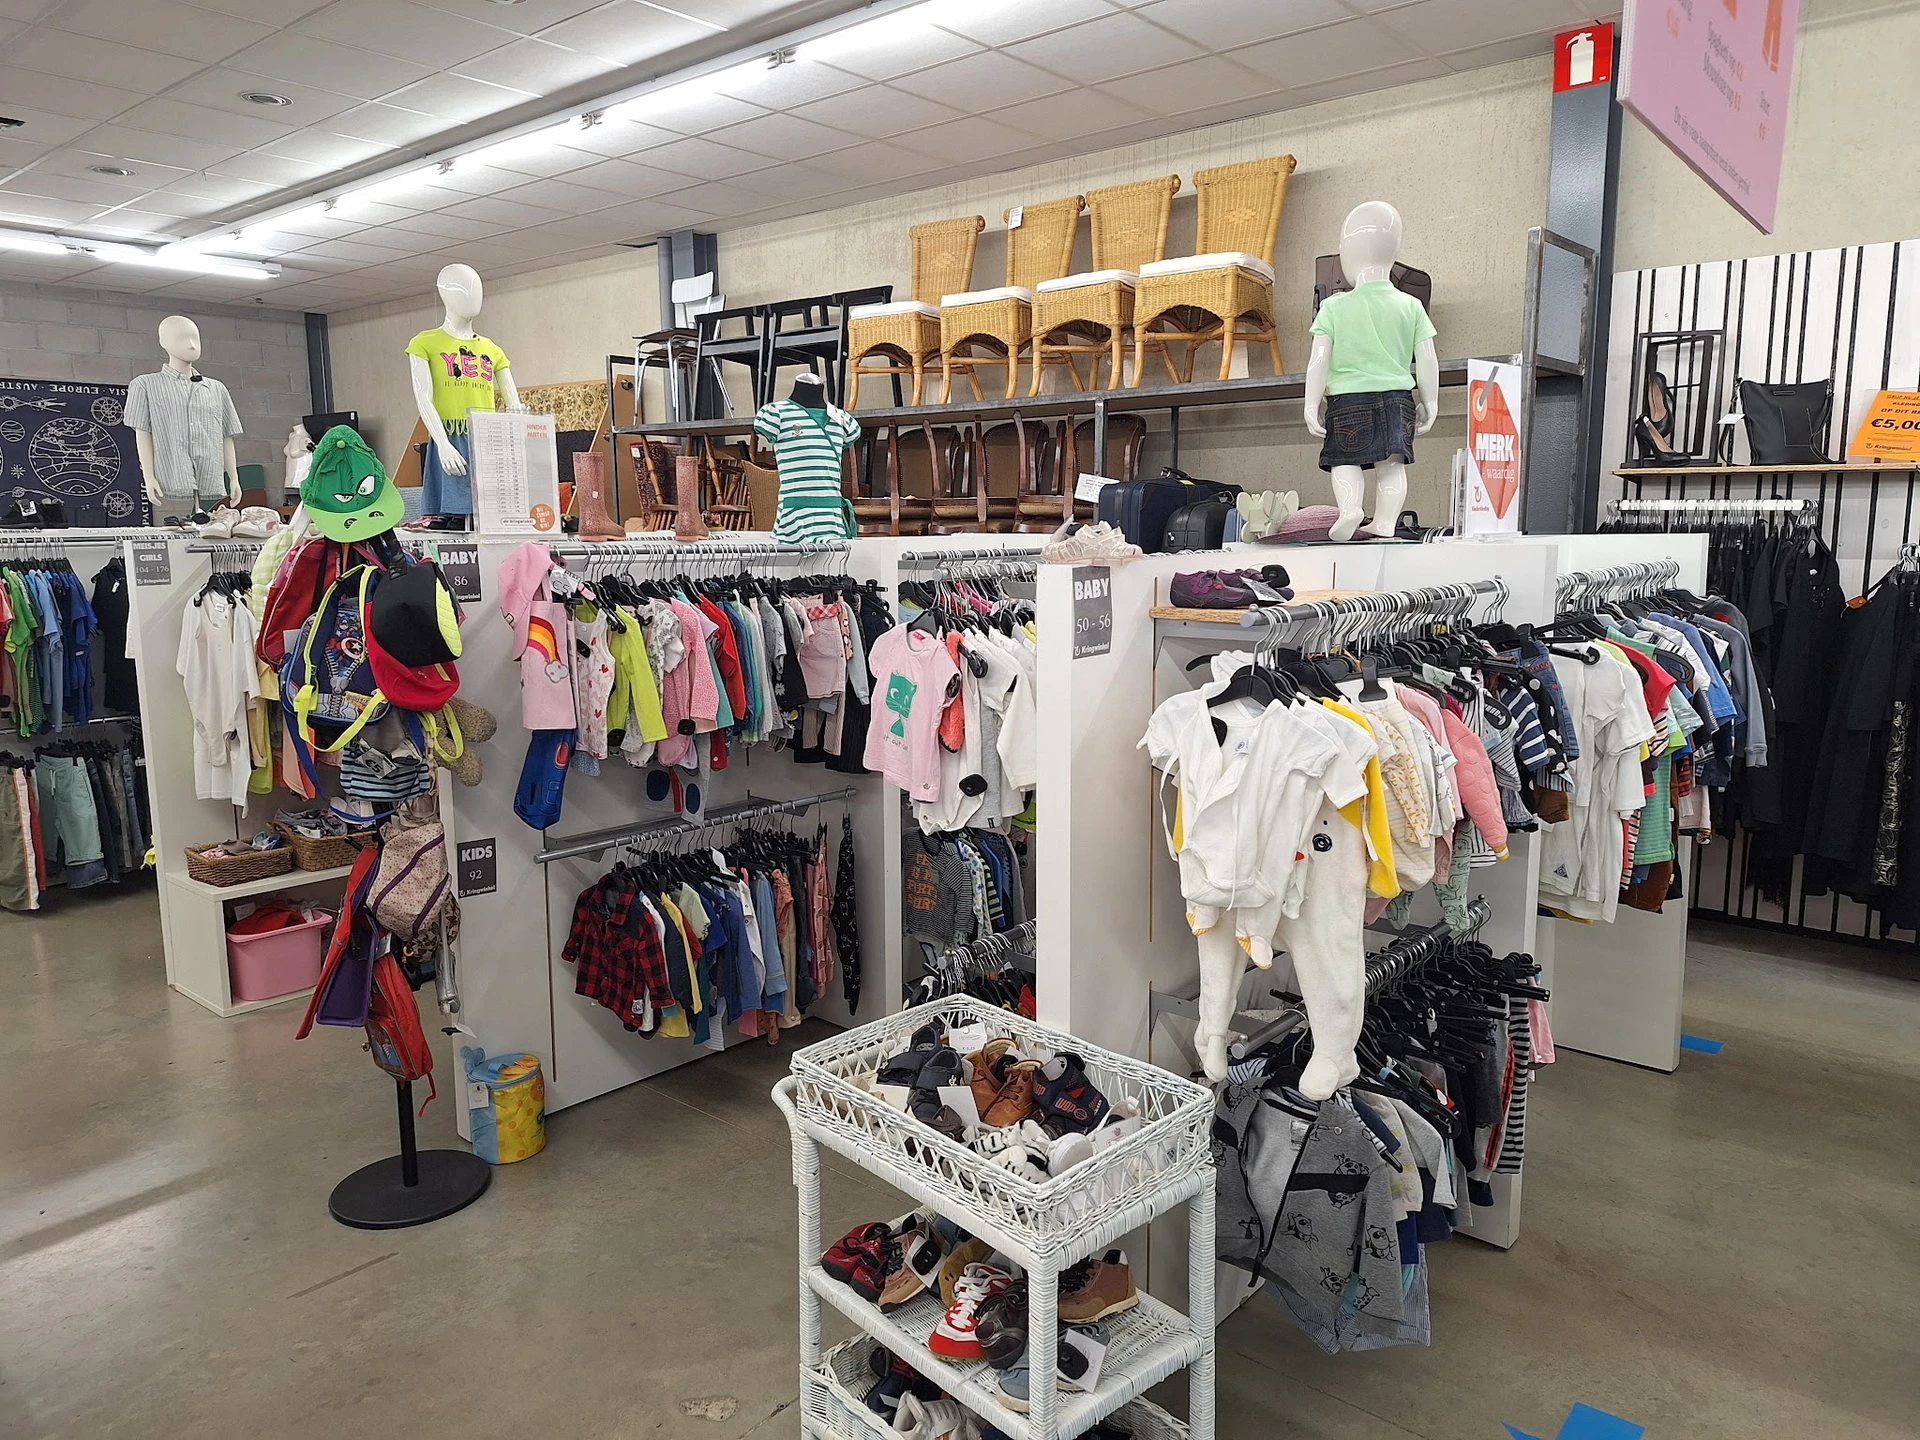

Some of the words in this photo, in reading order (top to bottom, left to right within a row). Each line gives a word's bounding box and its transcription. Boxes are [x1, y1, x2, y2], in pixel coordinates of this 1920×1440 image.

[440, 352, 493, 381] YES
[49, 384, 99, 394] EUROPE
[109, 388, 128, 396] SIA
[1476, 432, 1515, 461] MERK
[133, 542, 167, 550] MEISJES
[139, 553, 163, 561] GIRLS
[440, 551, 478, 565] BABY
[454, 575, 468, 586] 86
[1074, 577, 1110, 601] BABY
[1076, 617, 1090, 634] 50
[1098, 613, 1111, 631] 56
[461, 845, 493, 862] KIDS
[469, 869, 483, 881] 92
